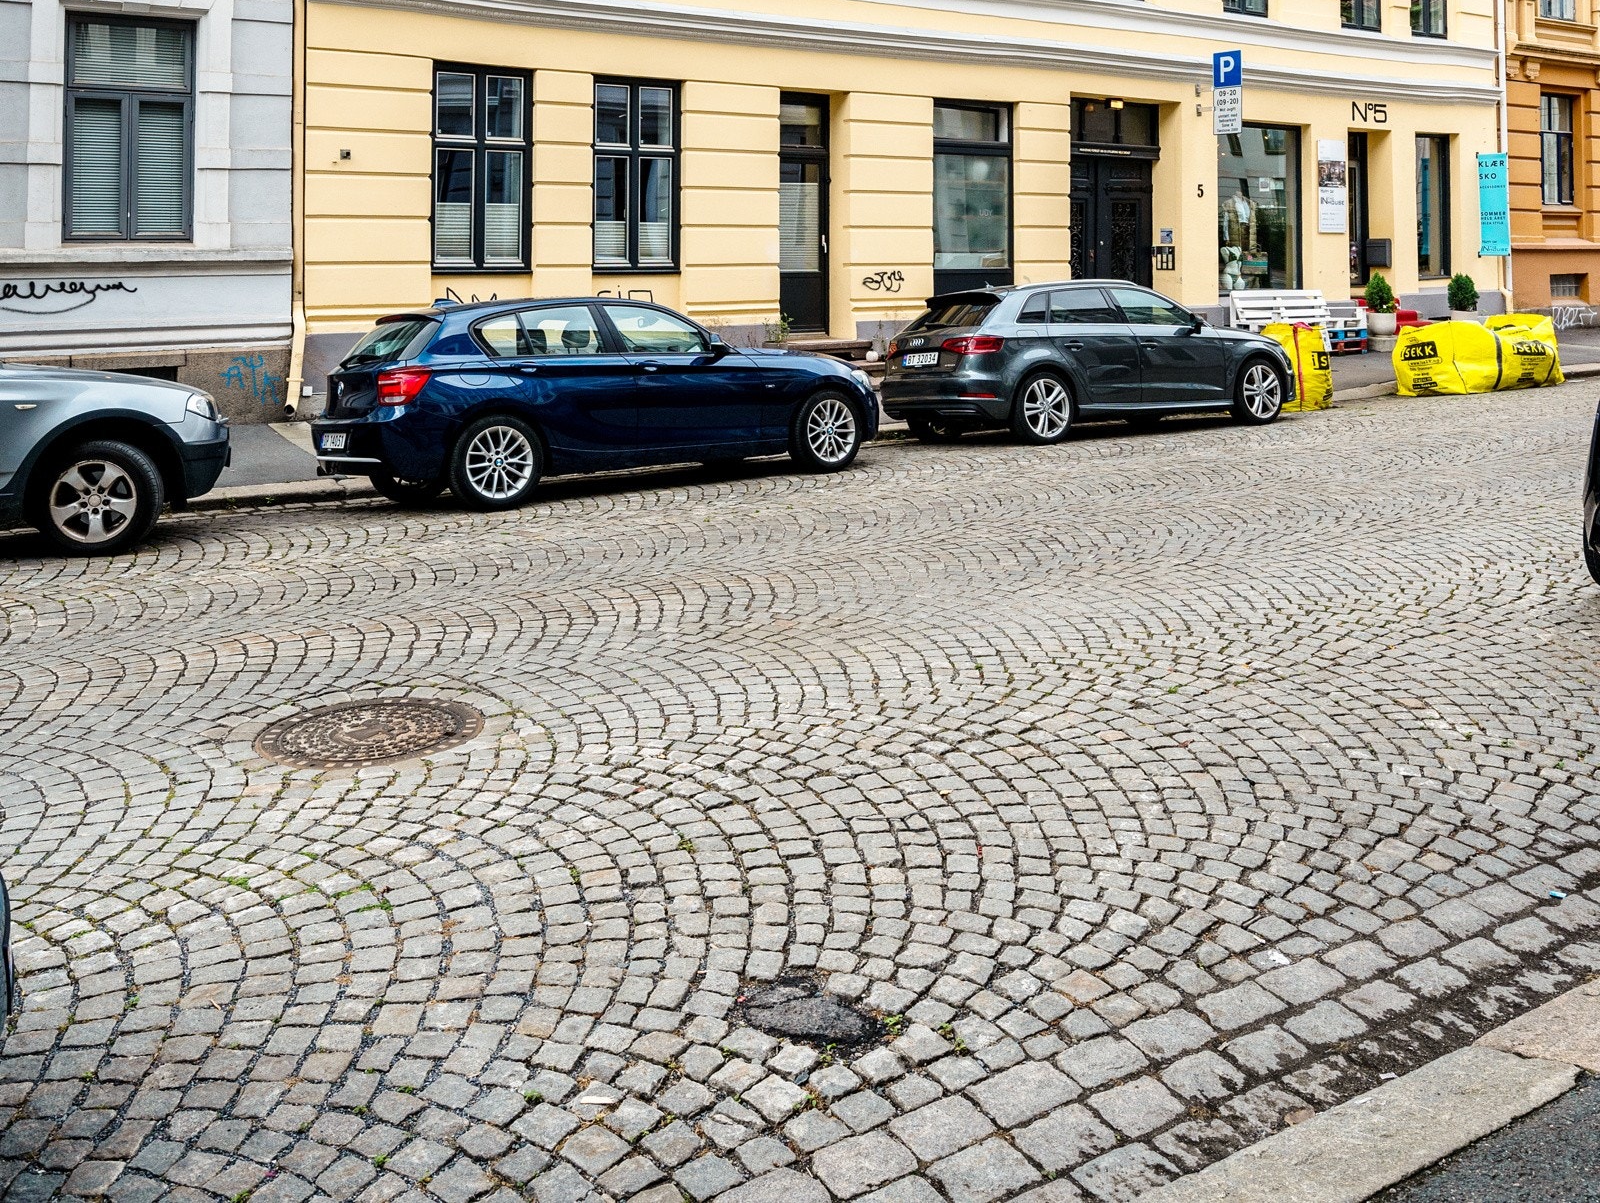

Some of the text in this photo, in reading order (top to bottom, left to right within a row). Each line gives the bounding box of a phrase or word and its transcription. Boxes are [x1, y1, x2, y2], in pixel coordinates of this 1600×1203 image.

[1220, 56, 1235, 83] P
[1218, 89, 1237, 97] 09-20
[1216, 97, 1239, 106] (09-20)
[1478, 160, 1505, 168] KLÆR
[1197, 184, 1204, 198] 5
[907, 353, 936, 365] BT 32034
